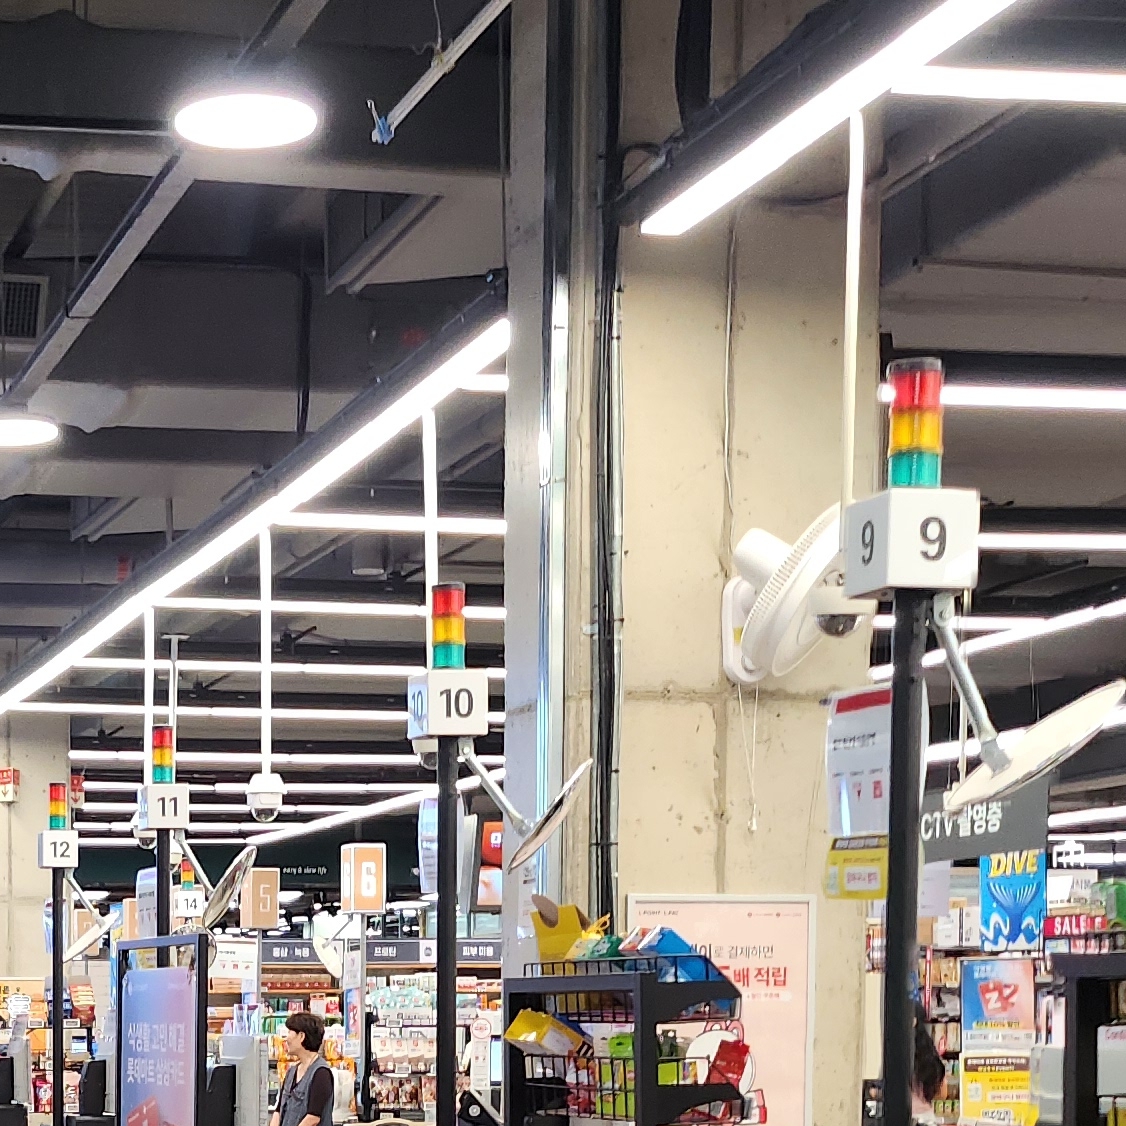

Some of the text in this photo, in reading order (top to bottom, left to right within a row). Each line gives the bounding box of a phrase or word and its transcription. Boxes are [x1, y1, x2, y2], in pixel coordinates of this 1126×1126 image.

[862, 520, 874, 566] 9
[920, 516, 947, 561] 9
[412, 690, 423, 721] 10
[439, 688, 473, 718] 10
[158, 796, 179, 817] 11
[49, 841, 71, 858] 12
[988, 848, 1039, 878] DIVE
[361, 861, 377, 897] 6
[184, 898, 198, 910] 14
[259, 884, 271, 912] 5
[1054, 914, 1086, 936] SALE
[728, 944, 774, 959] 결제하면
[754, 966, 787, 987] 적립
